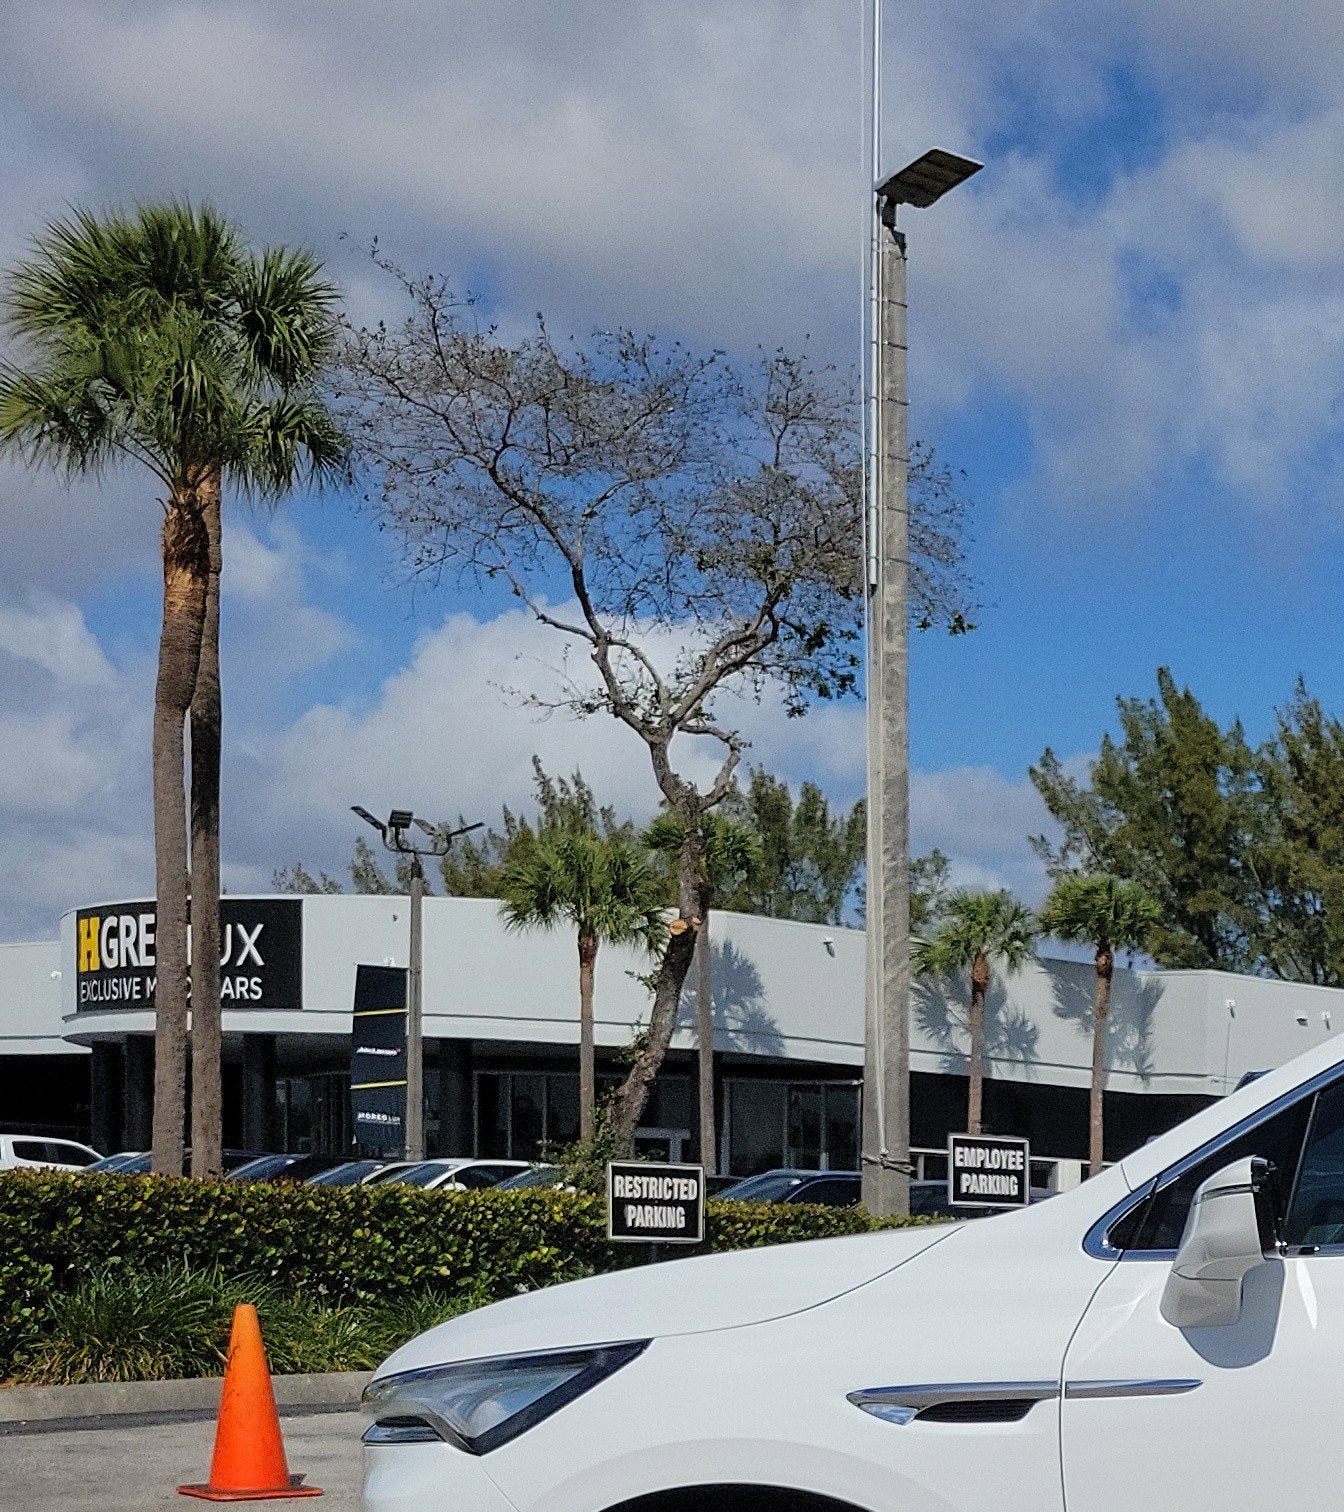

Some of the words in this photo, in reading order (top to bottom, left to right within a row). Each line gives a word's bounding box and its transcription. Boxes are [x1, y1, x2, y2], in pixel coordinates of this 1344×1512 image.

[79, 914, 157, 972] HGRE
[81, 977, 141, 1002] EXCLUSIVE
[220, 976, 263, 1000] ARS
[955, 1146, 1024, 1170] EMPLOYEE
[614, 1174, 698, 1200] RESTRICTED
[961, 1173, 1018, 1196] PARKING
[626, 1204, 686, 1229] PARKING
